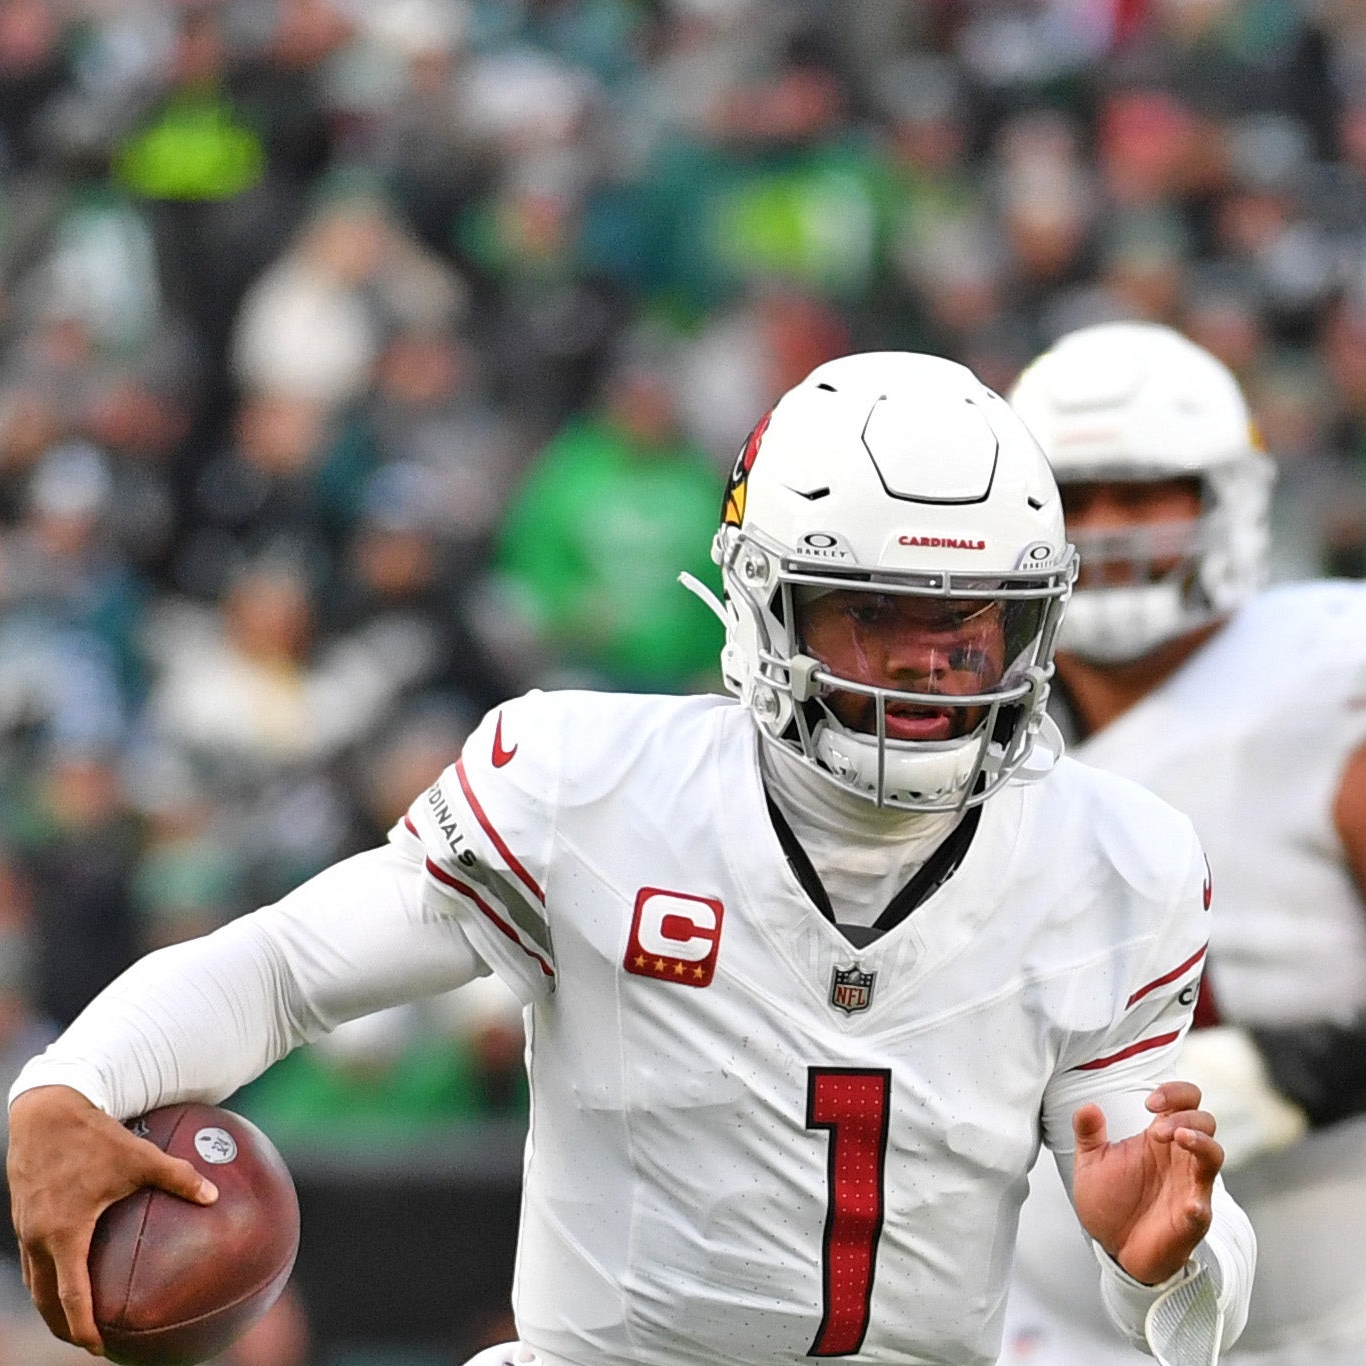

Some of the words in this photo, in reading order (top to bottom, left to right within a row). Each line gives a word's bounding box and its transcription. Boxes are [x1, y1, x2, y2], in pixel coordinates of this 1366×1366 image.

[796, 547, 849, 558] OAKLEY
[898, 535, 986, 550] CARDINALS
[429, 784, 477, 868] DINALS
[637, 893, 717, 962] C
[836, 985, 866, 1008] NFL
[805, 1065, 893, 1357] 1
